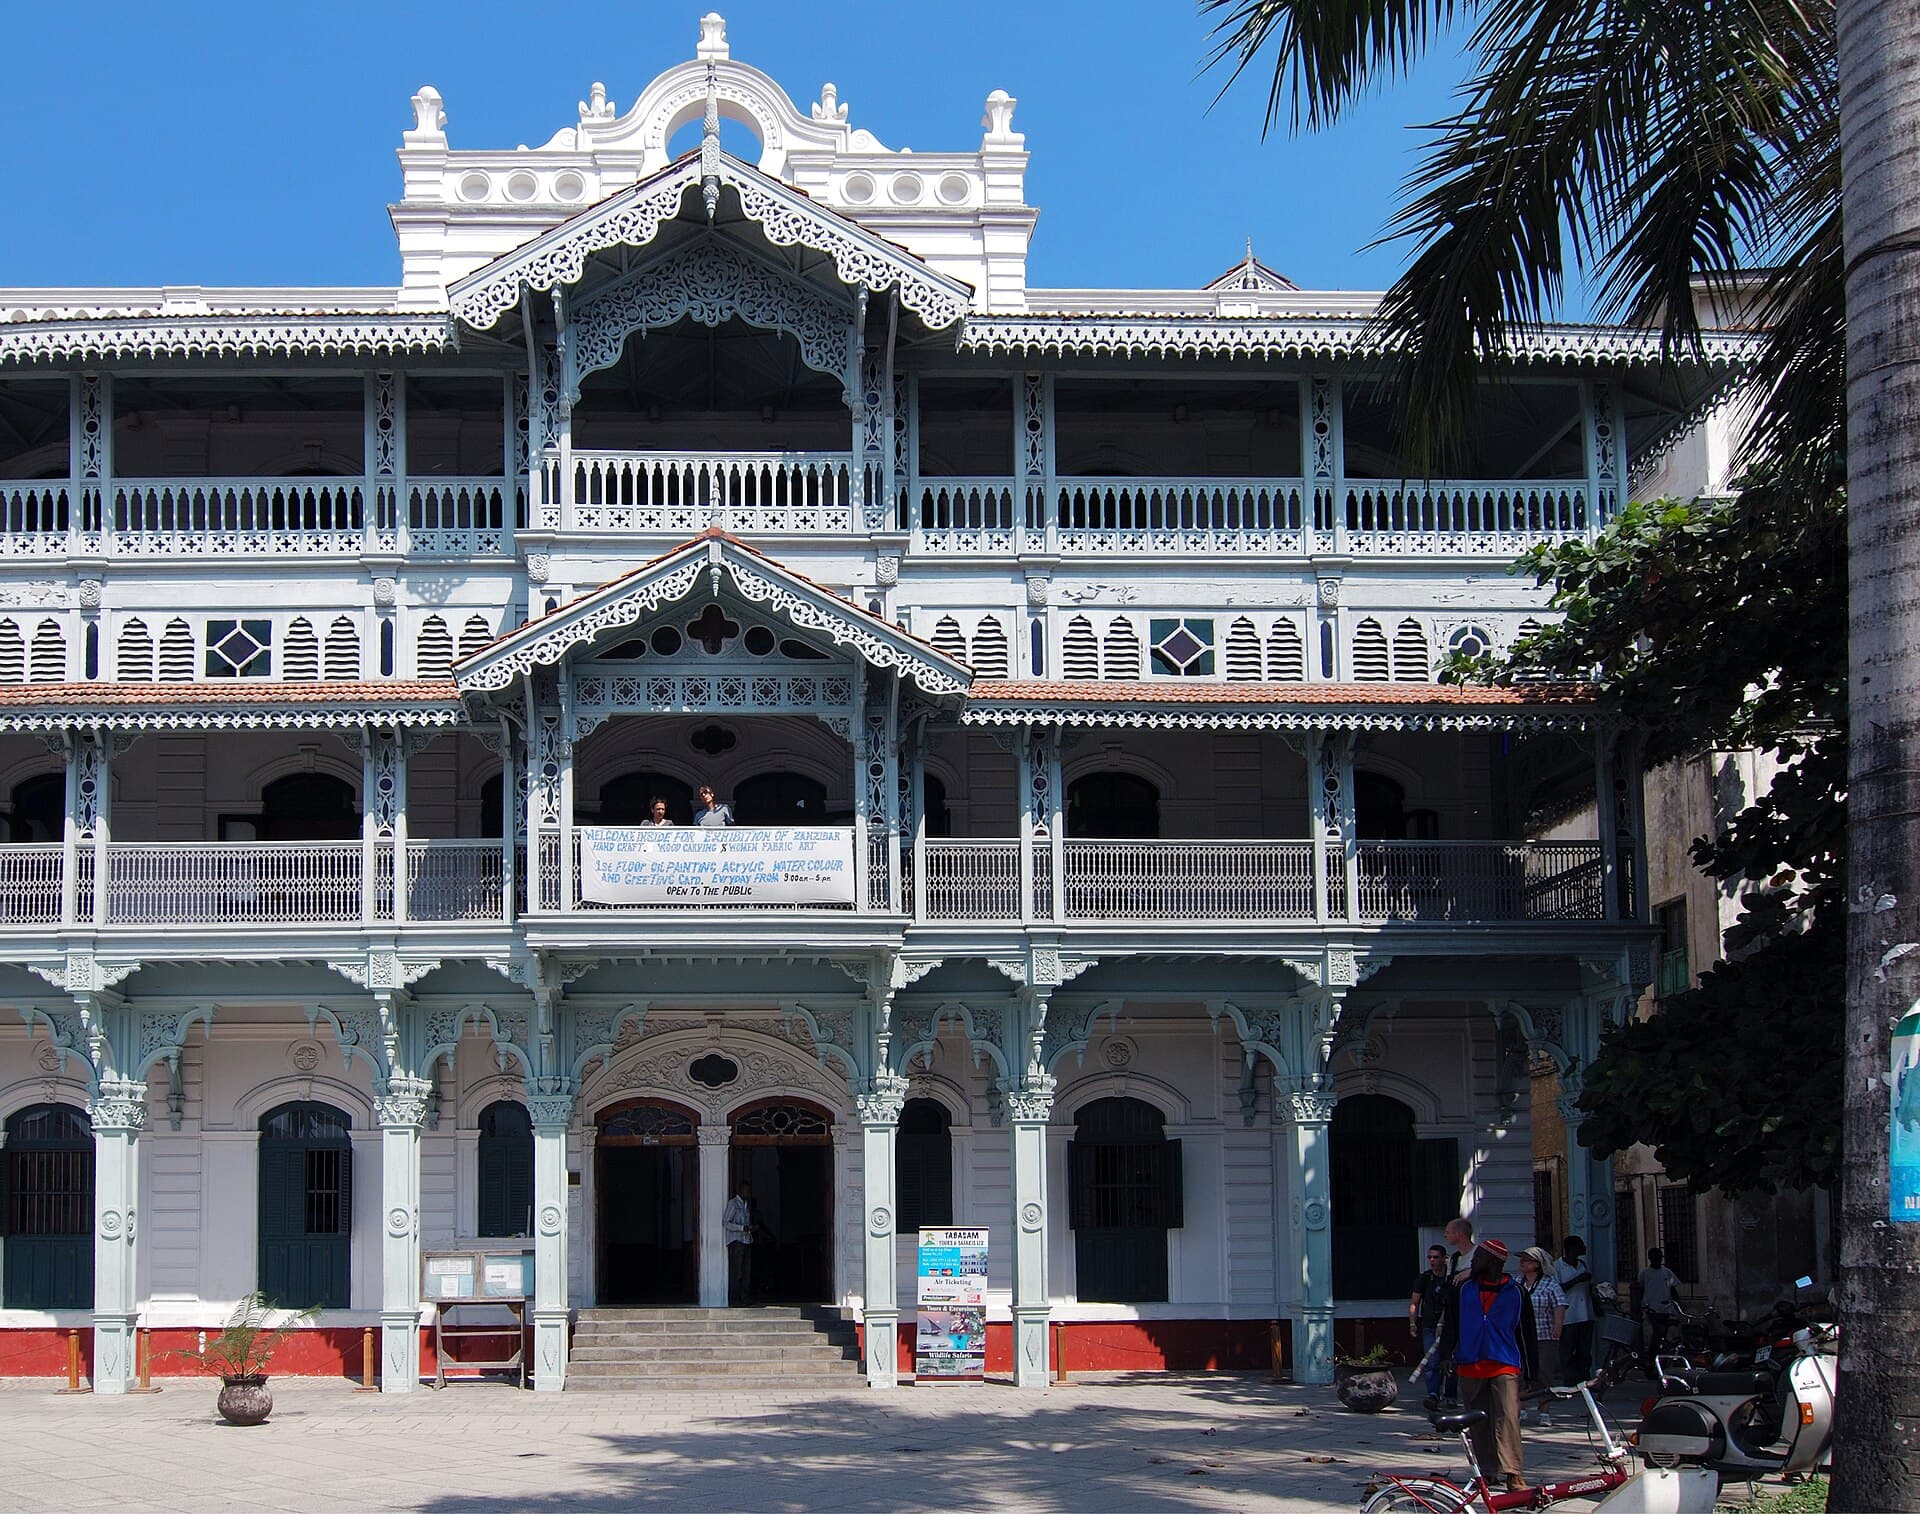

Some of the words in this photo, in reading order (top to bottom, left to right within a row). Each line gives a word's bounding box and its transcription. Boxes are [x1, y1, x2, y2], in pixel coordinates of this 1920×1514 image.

[586, 830, 635, 841] WELCOME
[636, 831, 671, 842] INSIDE
[673, 831, 695, 842] FOR
[774, 831, 789, 841] OF
[793, 831, 841, 841] ZANZIBAR
[593, 841, 615, 852] HAND
[729, 842, 757, 852] WOMEN
[761, 842, 793, 852] FABRIC
[799, 842, 817, 851] ART
[665, 861, 716, 874] PAINTING
[772, 860, 806, 873] WATER
[807, 859, 844, 872] COLOUR
[601, 872, 621, 884] AND
[753, 872, 779, 884] FROM
[666, 886, 688, 896] OPEN
[703, 886, 719, 896] THE
[722, 885, 753, 896] PUBLIC
